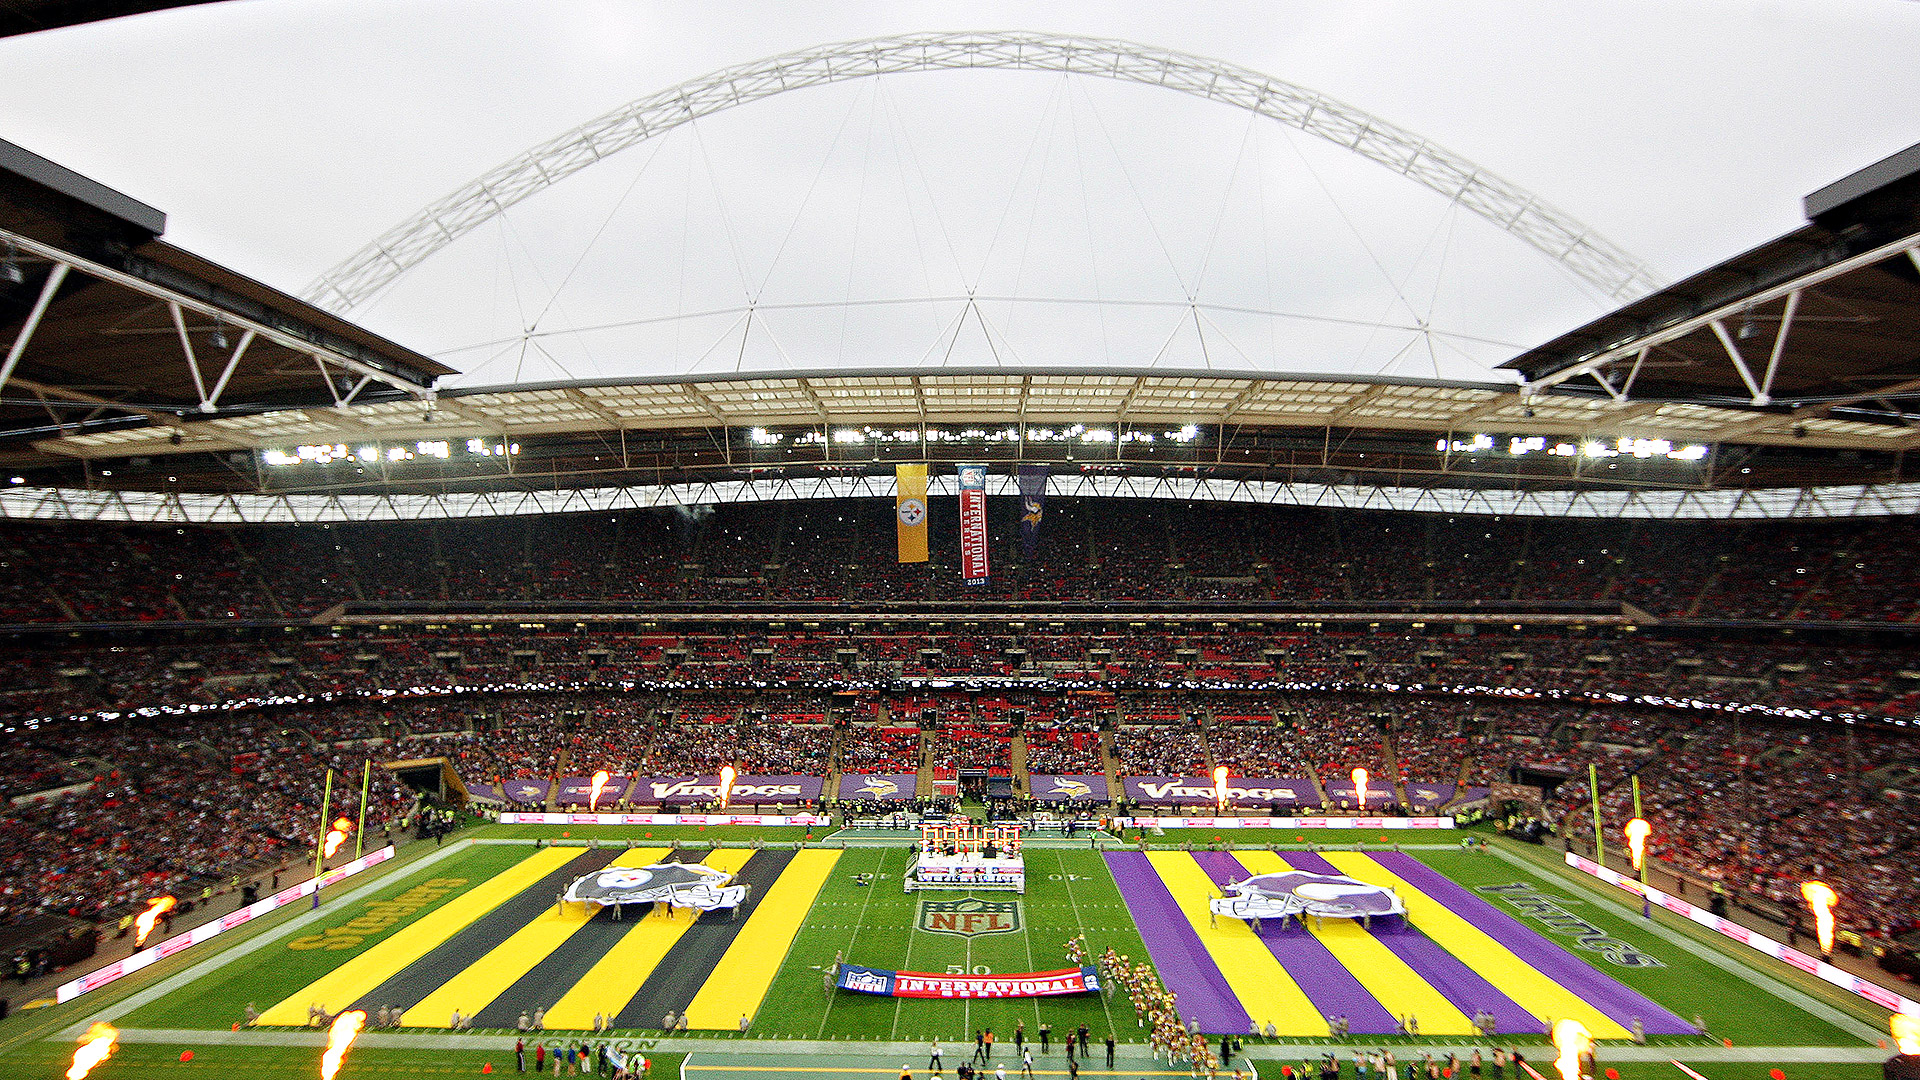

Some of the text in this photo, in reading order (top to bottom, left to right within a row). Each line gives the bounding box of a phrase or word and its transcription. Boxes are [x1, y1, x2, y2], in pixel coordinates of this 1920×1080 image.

[963, 510, 971, 556] SERIES
[970, 491, 985, 576] INTERNATIONAL
[967, 578, 985, 586] 2013
[650, 777, 802, 799] VIKNGS
[1137, 778, 1297, 800] VIKNGS
[930, 913, 1011, 932] NFL
[945, 964, 991, 975] 50
[899, 978, 1080, 993] INTERNATIONAL
